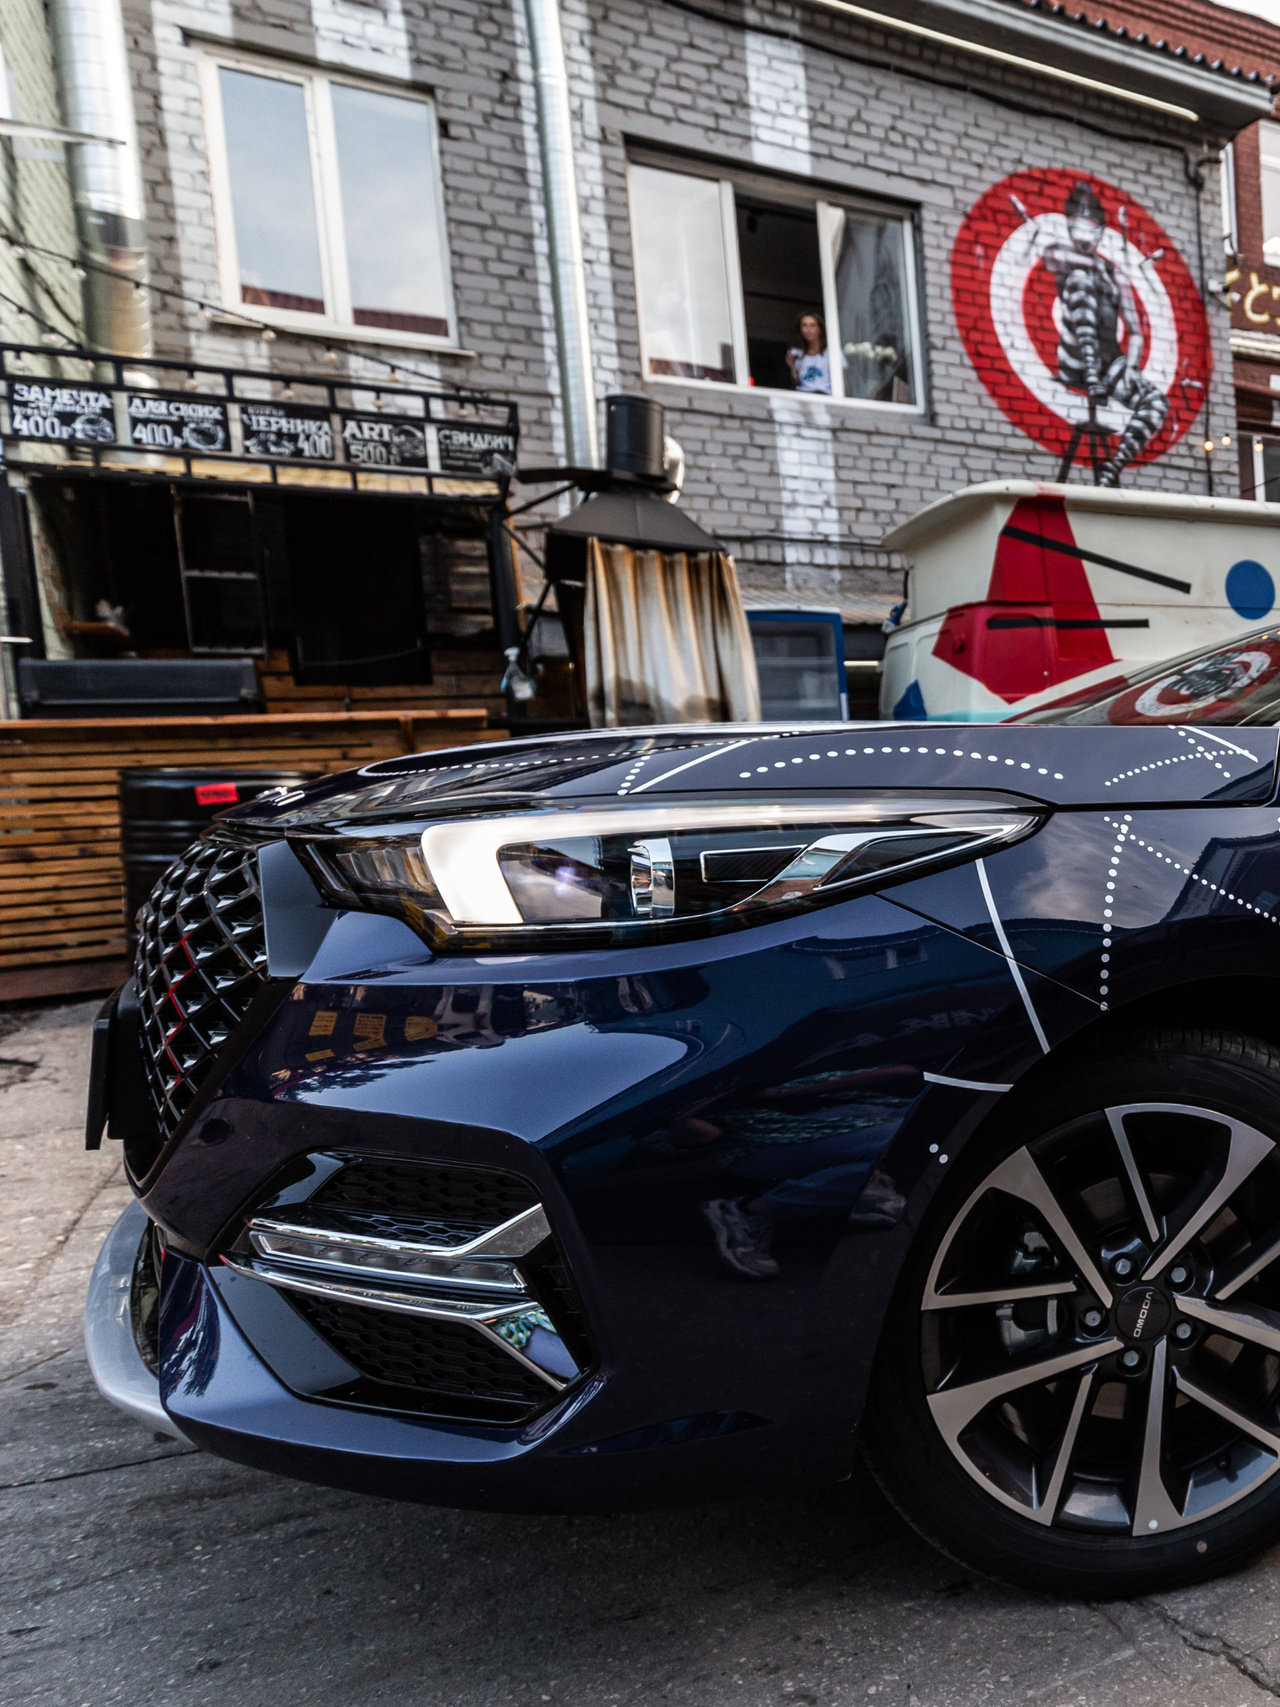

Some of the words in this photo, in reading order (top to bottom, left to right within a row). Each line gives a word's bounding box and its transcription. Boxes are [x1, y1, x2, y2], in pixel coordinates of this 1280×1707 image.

[241, 413, 332, 436] ЧЕРНИКА
[342, 420, 394, 441] ART
[438, 429, 514, 451] СЭНДВИЧ
[1133, 1291, 1154, 1338] OMODA
